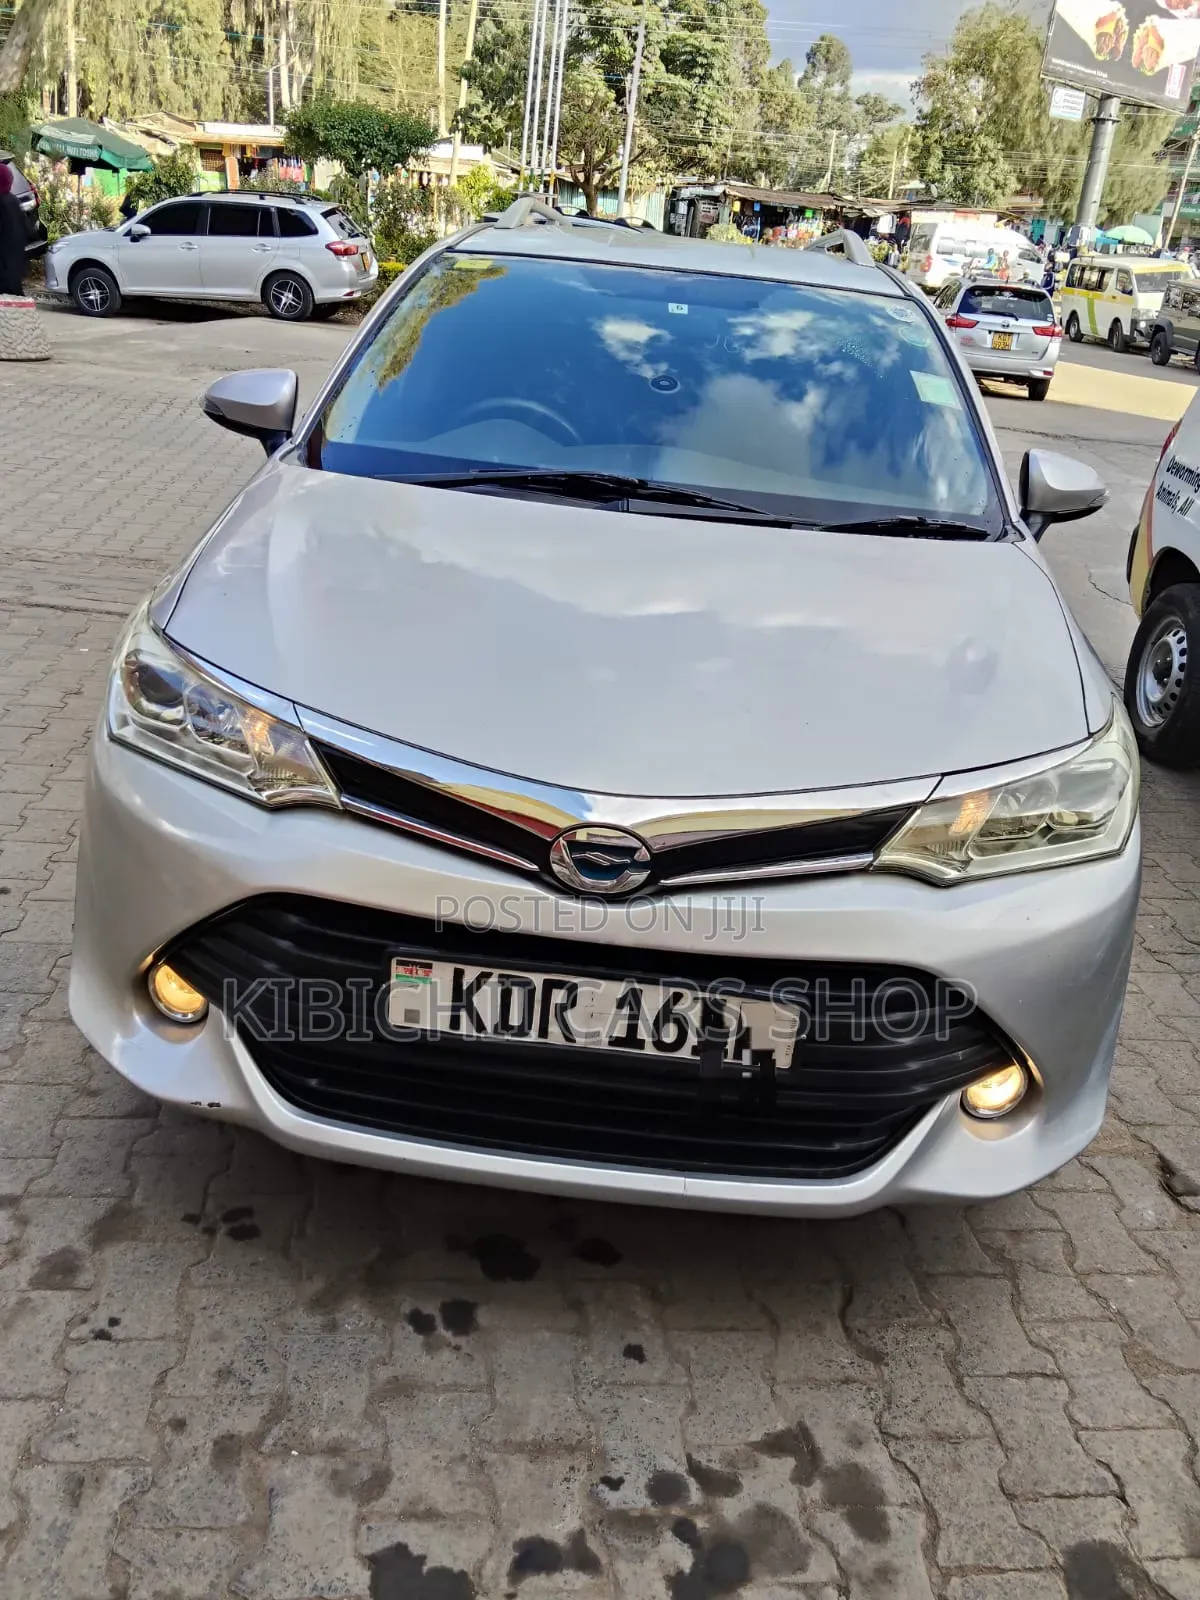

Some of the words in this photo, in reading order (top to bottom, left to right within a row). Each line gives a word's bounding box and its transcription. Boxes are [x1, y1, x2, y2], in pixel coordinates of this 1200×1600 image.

[1166, 455, 1200, 493] Deworming
[1177, 496, 1195, 517] All
[449, 967, 578, 1043] KDR
